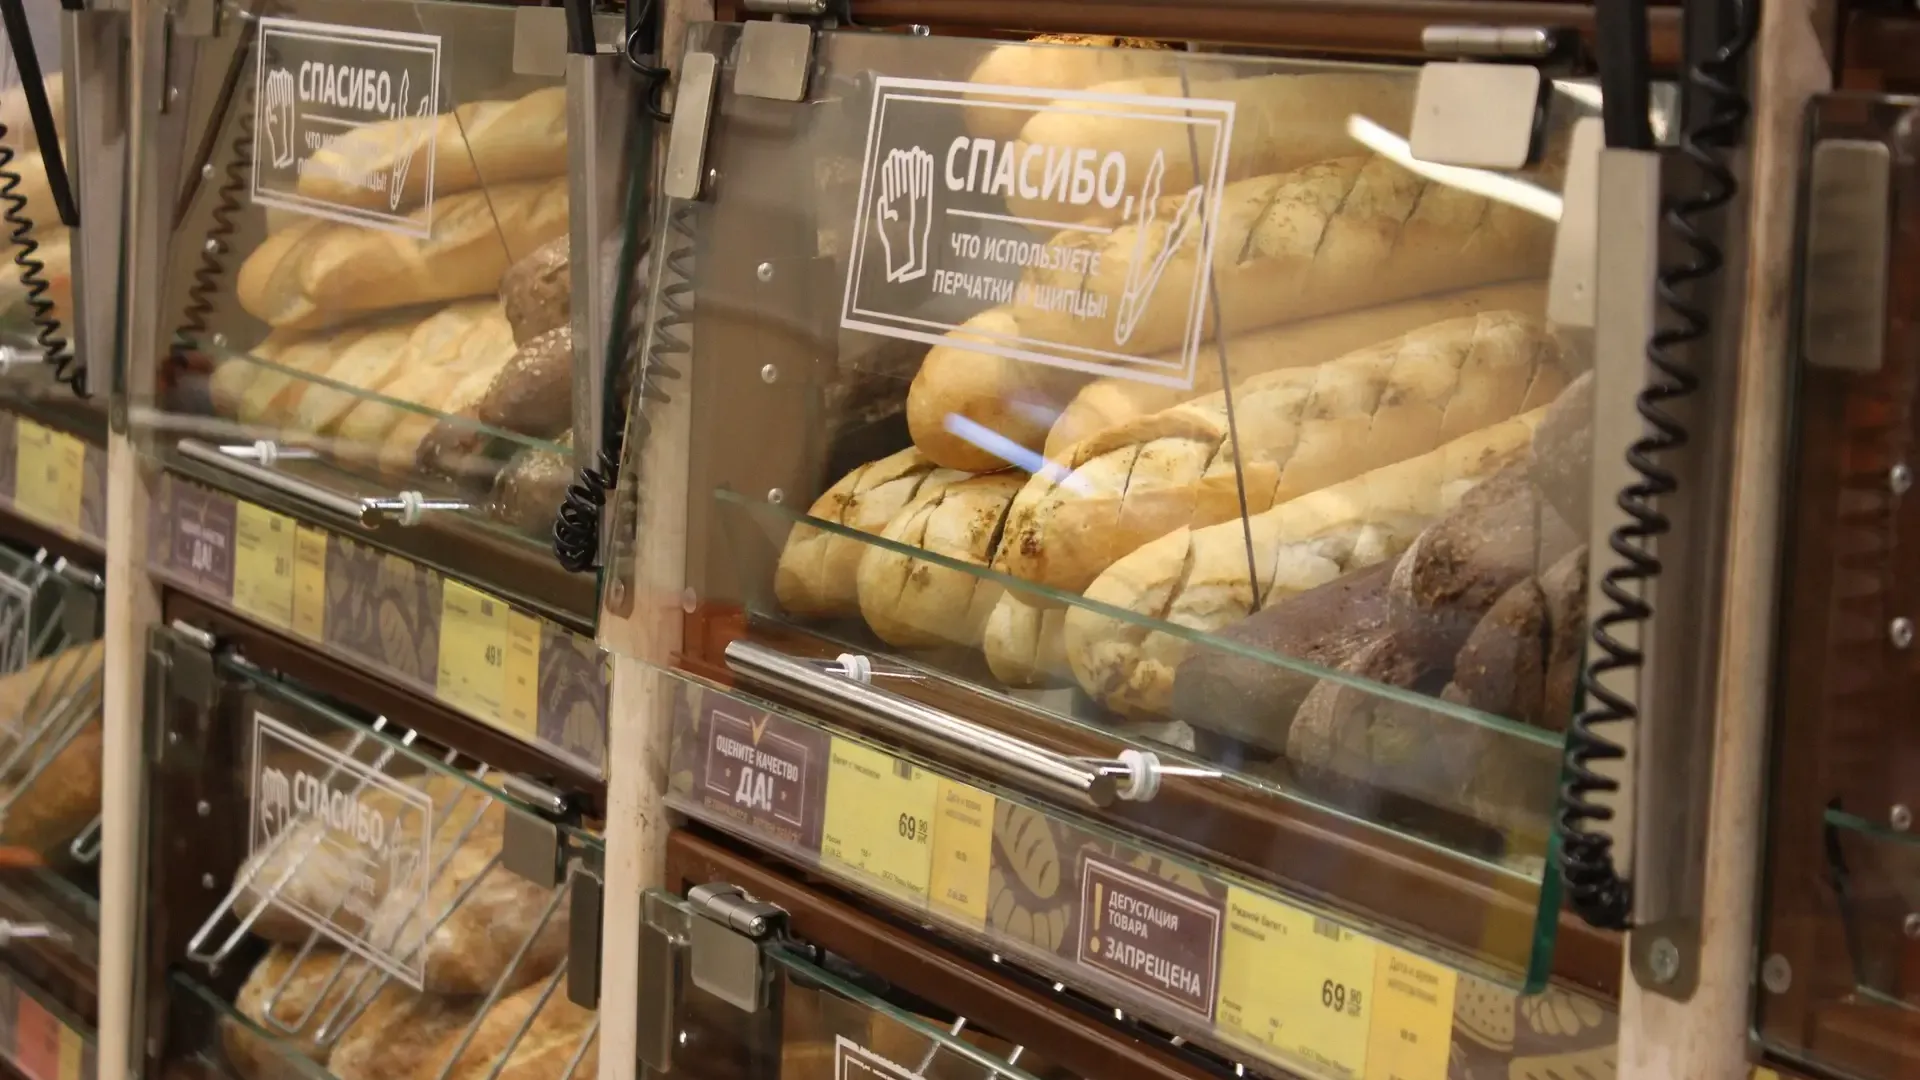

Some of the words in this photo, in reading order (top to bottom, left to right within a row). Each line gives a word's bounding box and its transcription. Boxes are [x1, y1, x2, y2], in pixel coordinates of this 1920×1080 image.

[299, 60, 396, 120] СПАСИБО,
[944, 136, 1134, 220] СПАСИБО,
[951, 231, 981, 259] ЧТО
[983, 236, 1102, 277] ИСПОЛЬЗУЕТЕ
[932, 269, 1014, 304] ПЕРЧАТКИ
[1034, 285, 1108, 320] ЩИПЦЫ!
[716, 734, 755, 764] ОЦЕНИТЕ
[756, 749, 798, 782] КАЧЕСТВО
[735, 766, 774, 812] ДА!
[293, 769, 390, 861] СПАСИБО,
[899, 812, 915, 840] 69
[1108, 890, 1179, 931] ДЕГУСТАЦИЯ
[1108, 908, 1149, 939] ТОВАРА
[1105, 936, 1201, 997] ЗАПРЕЩЕНА
[1322, 979, 1345, 1012] 69
